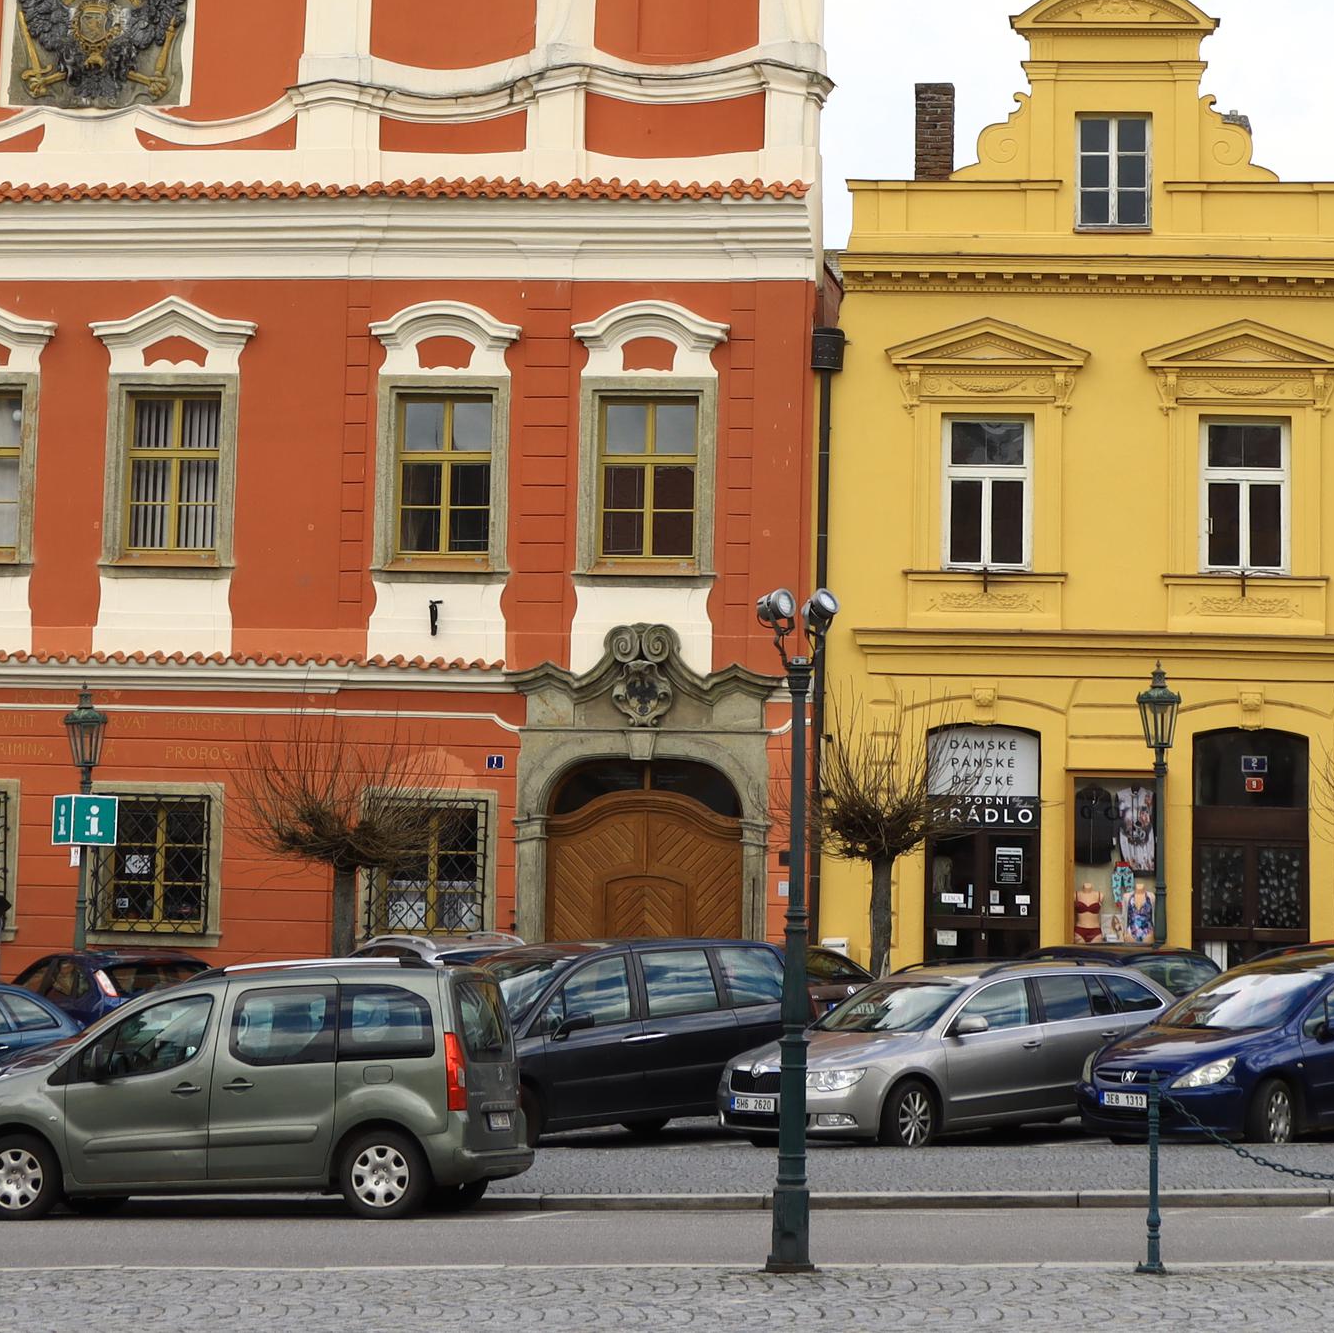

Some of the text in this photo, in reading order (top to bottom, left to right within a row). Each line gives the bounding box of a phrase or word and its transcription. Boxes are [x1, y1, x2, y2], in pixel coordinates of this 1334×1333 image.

[737, 1098, 772, 1110] 5H6 2620
[1126, 1095, 1144, 1107] 1313
